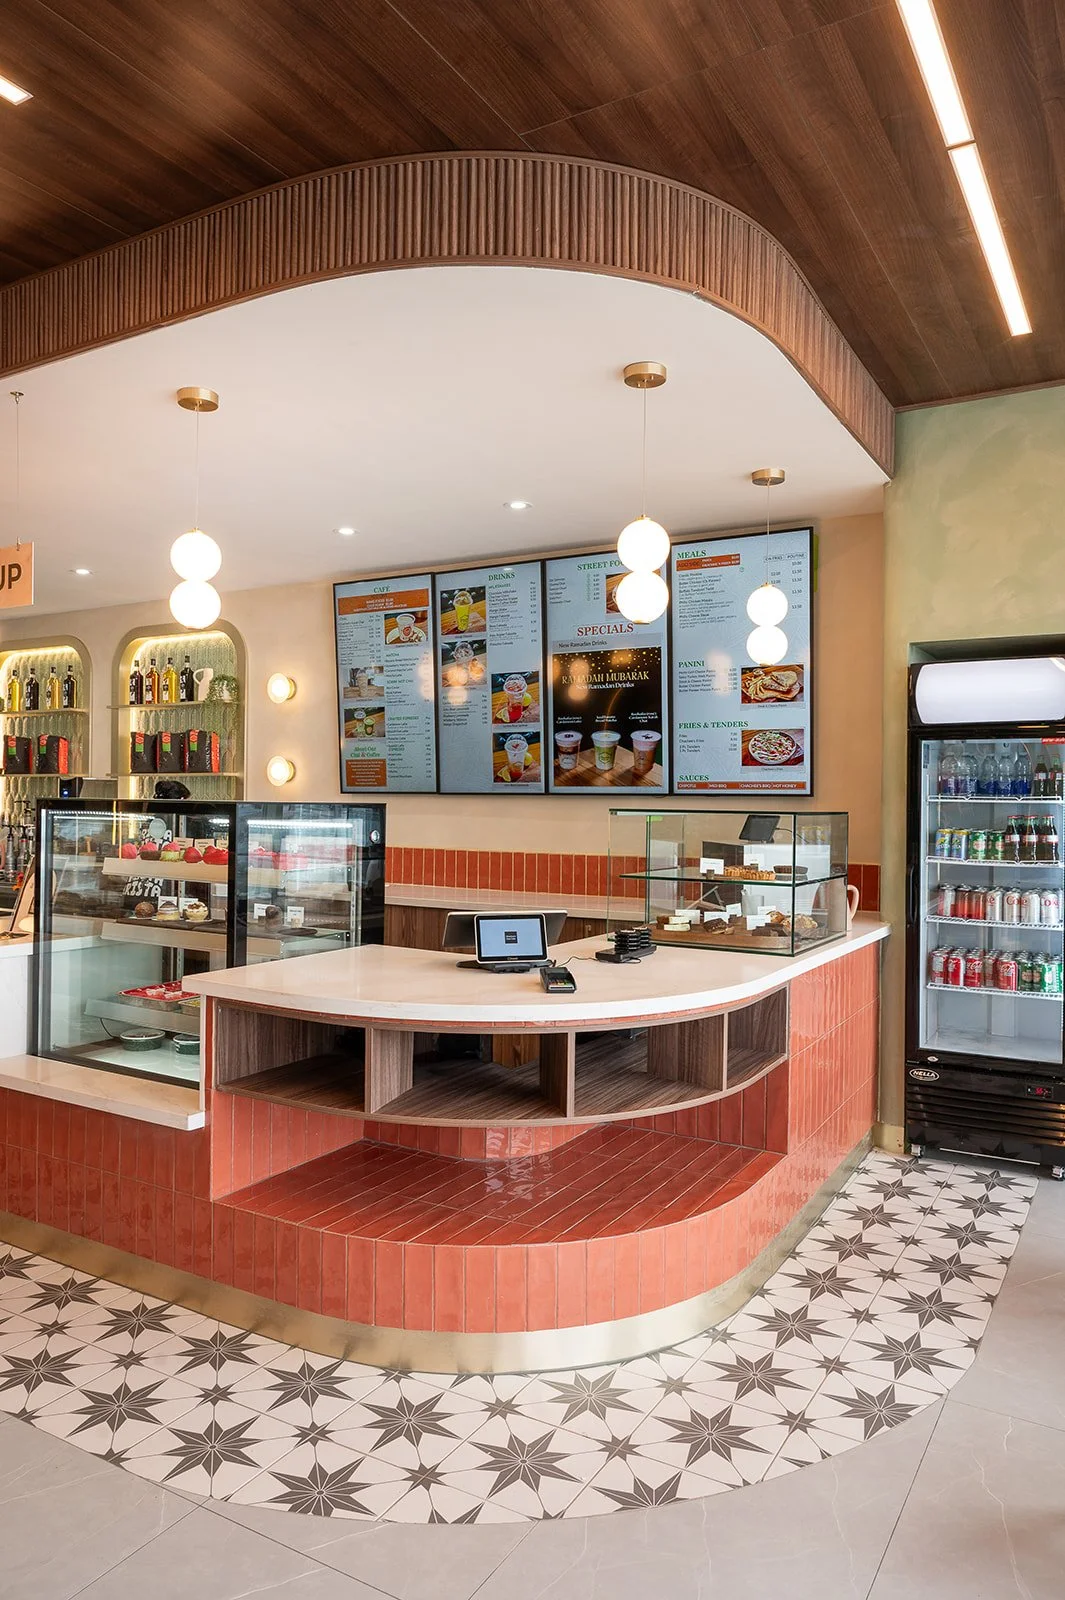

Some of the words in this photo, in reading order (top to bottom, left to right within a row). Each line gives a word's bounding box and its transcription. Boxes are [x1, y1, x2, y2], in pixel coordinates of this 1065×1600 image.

[677, 550, 706, 559] MEALS
[577, 561, 608, 571] STREET
[0, 563, 22, 590] UP
[488, 572, 515, 581] DRINKS
[374, 585, 390, 593] CAFÉ
[577, 623, 634, 637] SPECIALS
[606, 671, 649, 682] MUBARAK
[912, 1070, 936, 1078] NELLA
